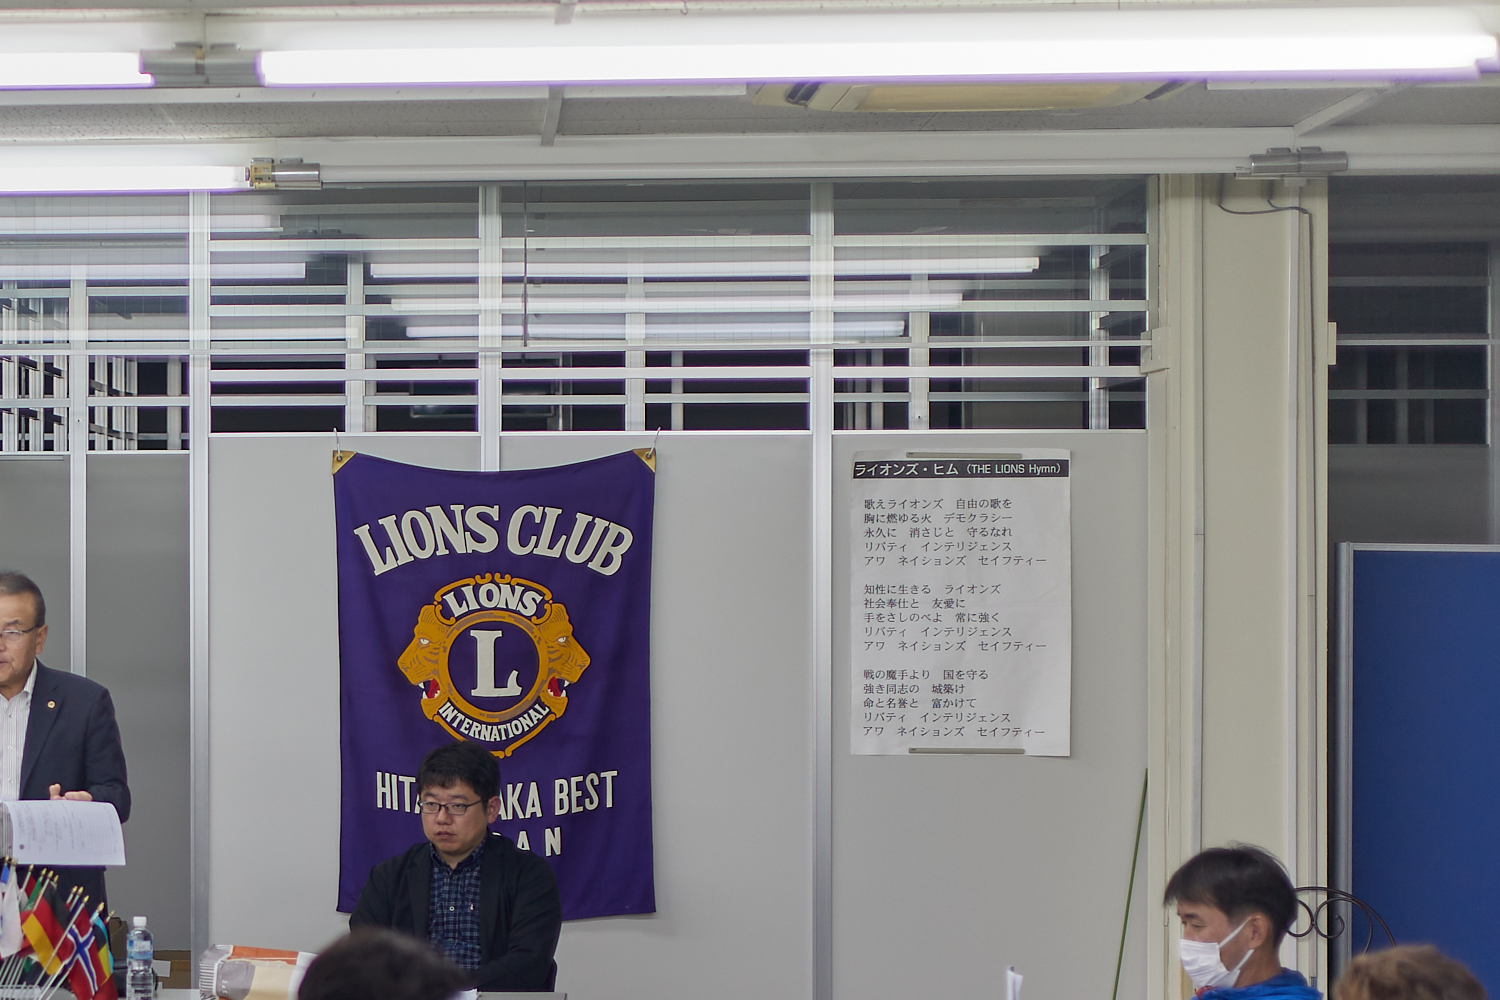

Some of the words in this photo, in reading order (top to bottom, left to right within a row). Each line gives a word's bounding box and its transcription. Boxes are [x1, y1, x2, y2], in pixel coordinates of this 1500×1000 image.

[854, 463, 959, 477] ライオンズ・ヒム
[995, 463, 1025, 474] LIONS
[863, 499, 943, 510] 歌えライオンズ
[956, 499, 1012, 510] 自由の歌を
[943, 513, 1013, 524] デモクラシー
[863, 527, 897, 538] 永久に
[909, 527, 954, 538] 消さじと
[966, 527, 1013, 538] 守るなれ
[353, 504, 500, 576] LIONS
[506, 504, 634, 577] CLUB
[920, 541, 1012, 552] インテリジェンス
[864, 555, 886, 567] アワ
[898, 555, 967, 567] ネイションズ
[978, 555, 1047, 567] セイフティー
[863, 584, 931, 595] 知性に生きる
[944, 584, 1001, 595] ライオンズ
[442, 582, 543, 618] LIONS
[863, 598, 920, 609] 社会奉仕と
[932, 598, 966, 609] 友愛に
[955, 612, 1000, 624] 常に強く
[920, 626, 1012, 638] インテリジェンス
[864, 641, 885, 652] アワ
[898, 641, 967, 652] ネイションズ
[977, 641, 1047, 652] セイフティー
[469, 629, 522, 697] L
[943, 669, 989, 681] 国を守る
[863, 683, 920, 695] 強き同志の
[863, 697, 919, 709] 命と名誉と
[931, 697, 977, 709] 富かけて
[437, 702, 550, 743] INTERNATIONAL
[920, 712, 1011, 723] インテリジェンス
[863, 726, 884, 738] アワ
[897, 726, 965, 738] ネイションズ
[976, 726, 1046, 738] セイフティー
[554, 770, 618, 816] BEST
